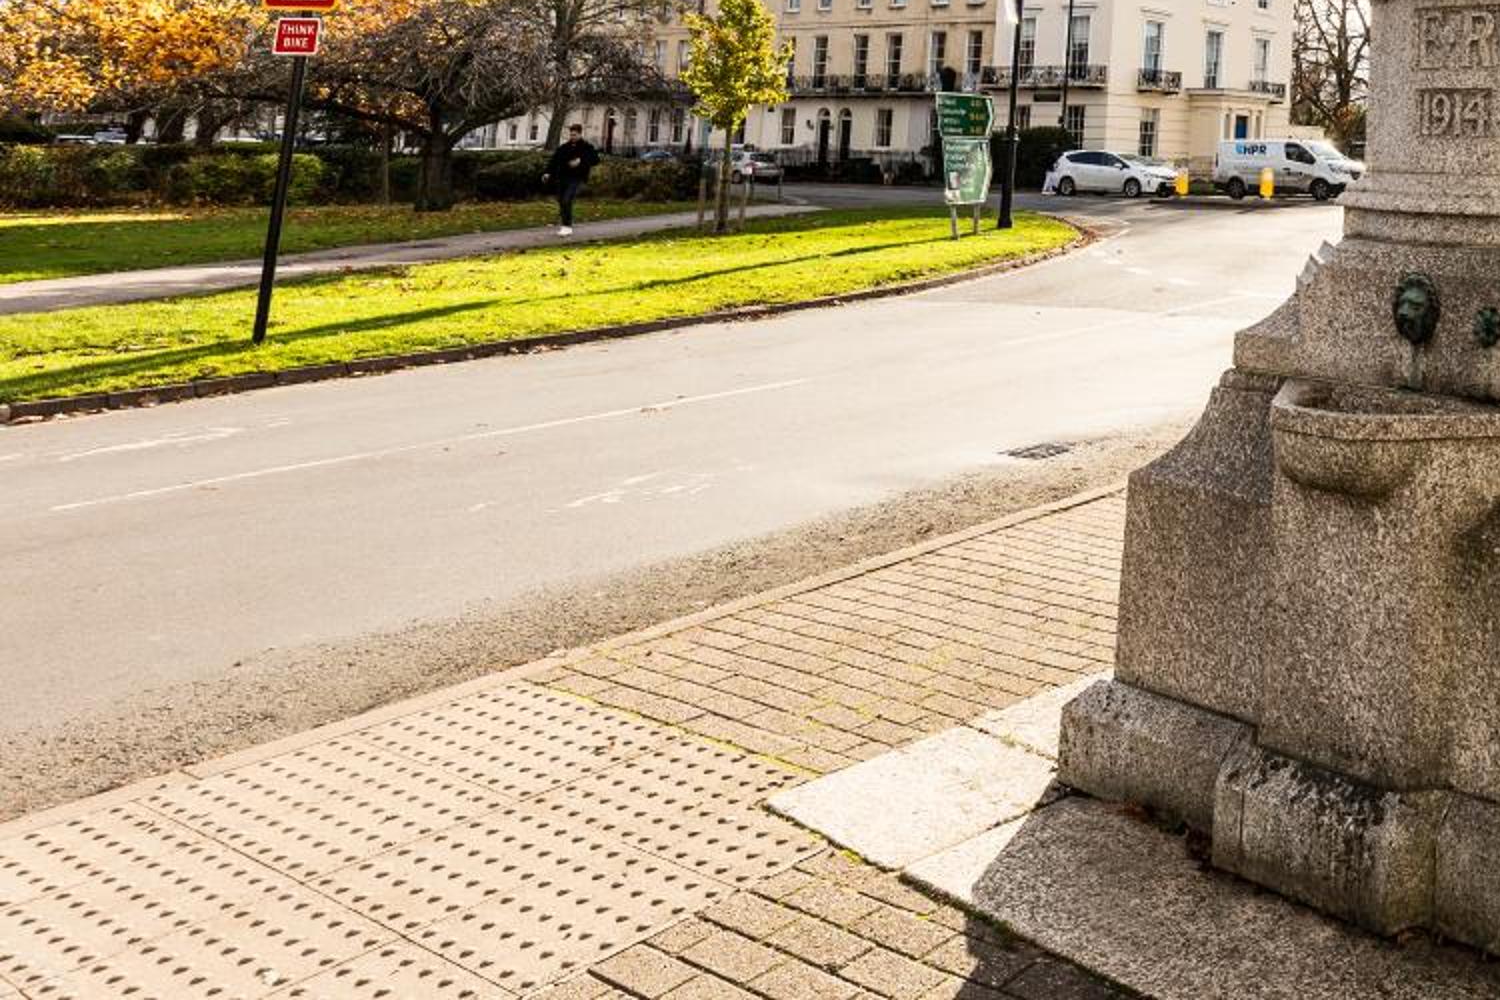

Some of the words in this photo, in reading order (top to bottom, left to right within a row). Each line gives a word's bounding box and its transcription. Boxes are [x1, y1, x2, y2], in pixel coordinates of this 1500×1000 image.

[281, 23, 315, 35] THINK
[283, 37, 309, 48] BIKE
[1420, 93, 1490, 136] 1914
